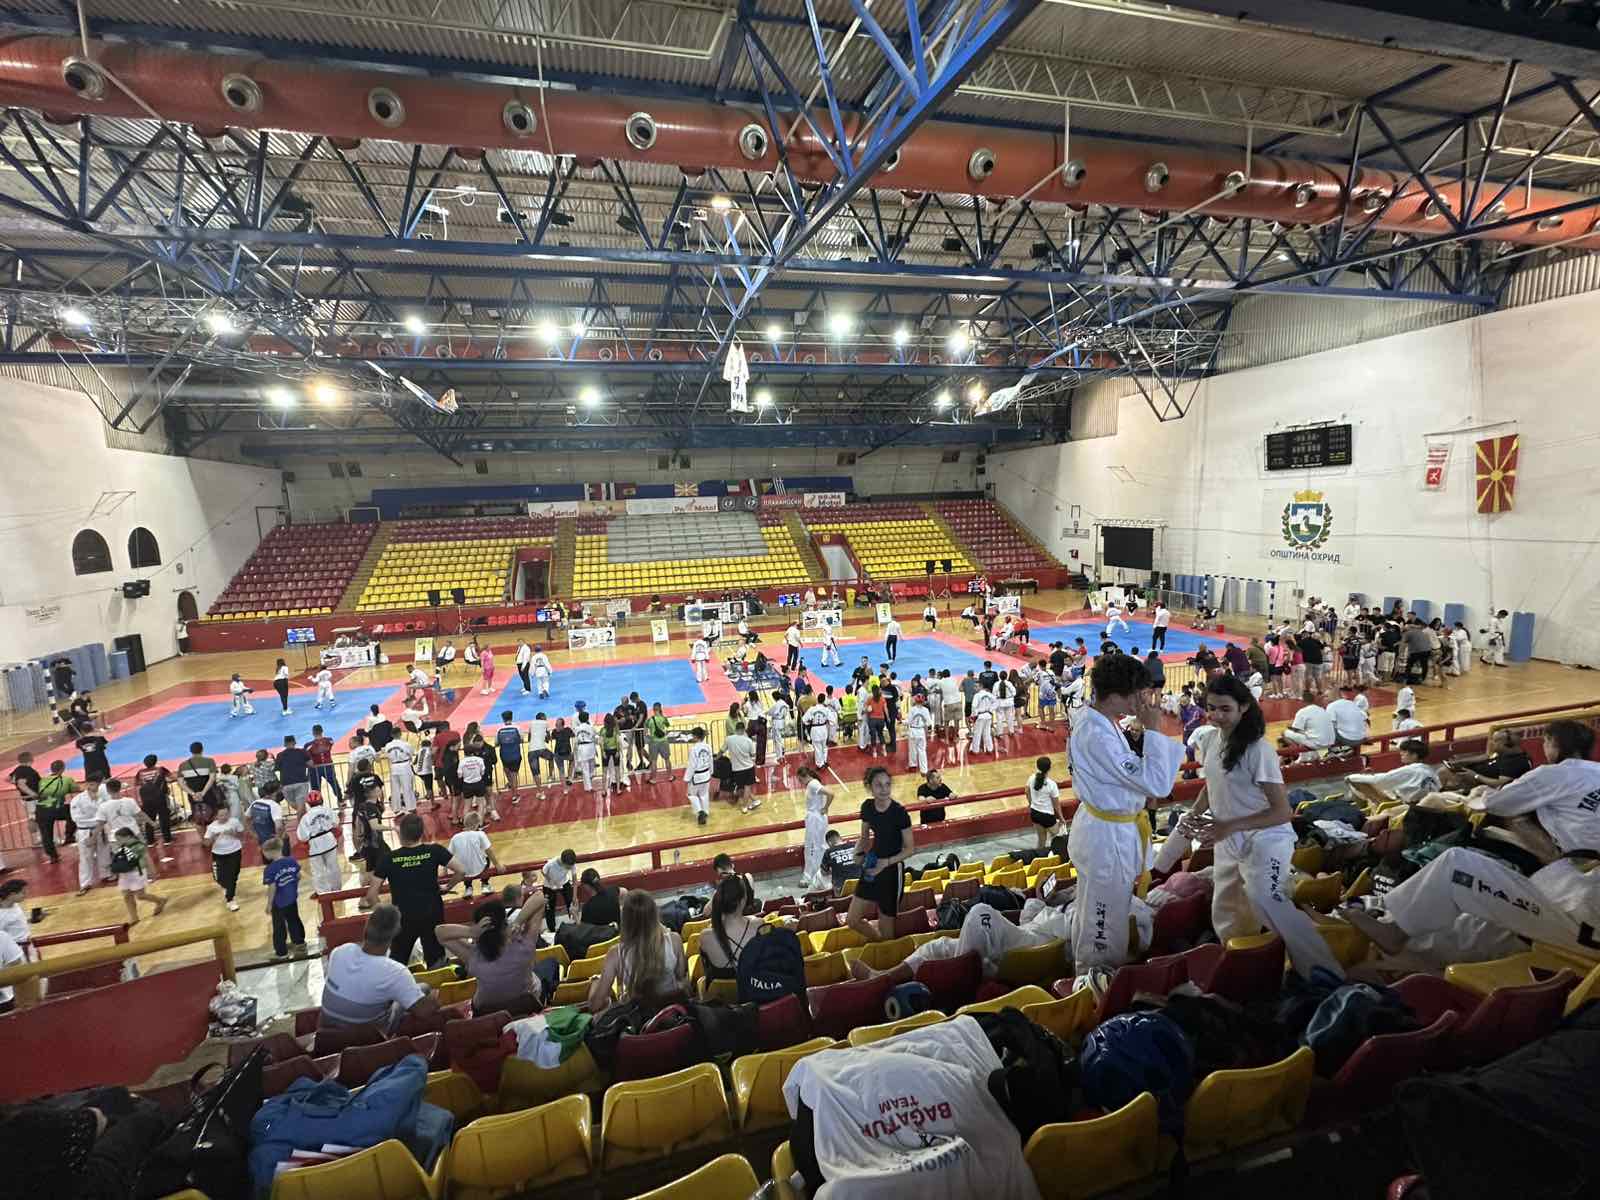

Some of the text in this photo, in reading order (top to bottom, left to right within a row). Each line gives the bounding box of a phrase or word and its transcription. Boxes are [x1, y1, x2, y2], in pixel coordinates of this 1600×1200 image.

[1270, 549, 1341, 564] ОПШТИНА ОХРИД
[606, 630, 613, 642] 2
[1577, 788, 1600, 814] TAE
[750, 976, 782, 991] ITALIA
[879, 1095, 919, 1114] TEAM
